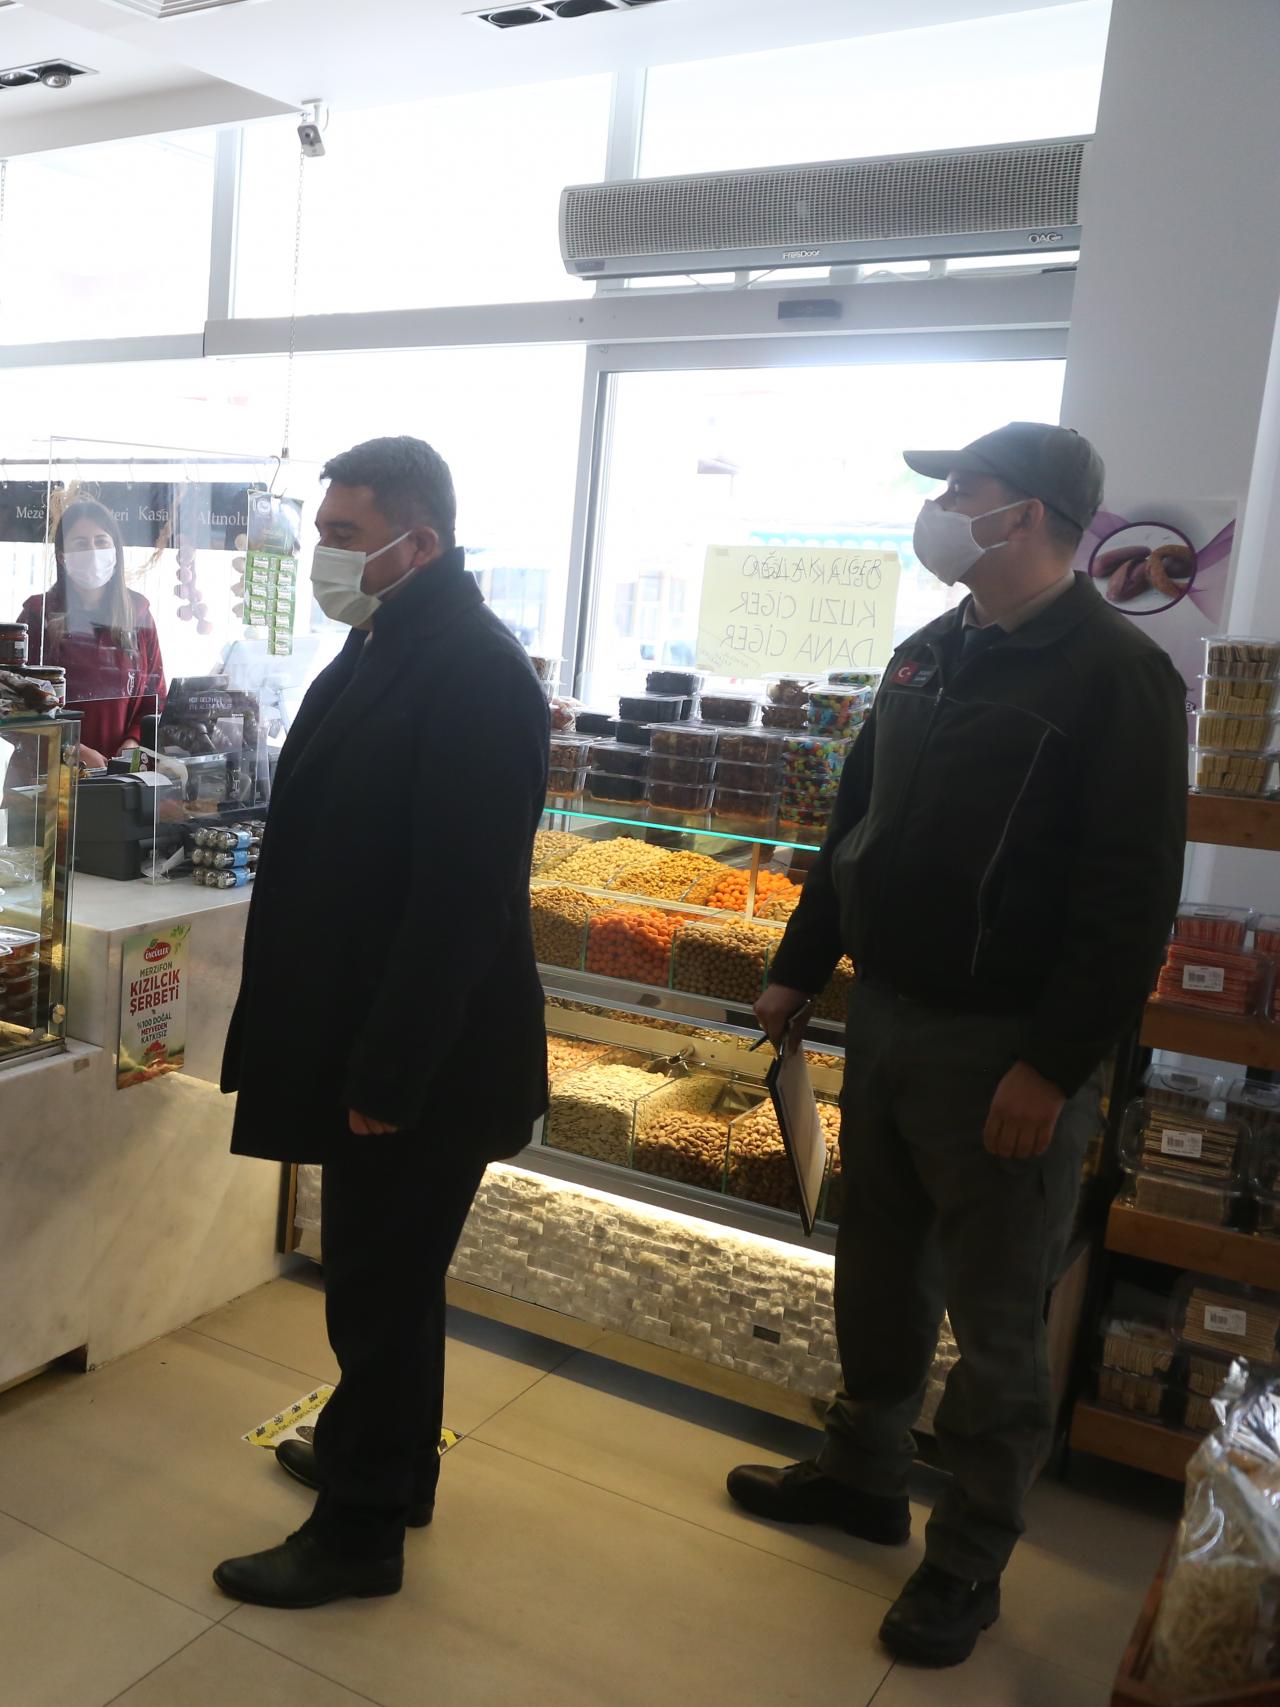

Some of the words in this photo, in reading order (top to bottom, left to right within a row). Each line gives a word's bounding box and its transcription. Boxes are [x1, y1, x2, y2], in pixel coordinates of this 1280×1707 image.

[15, 506, 45, 520] Meze
[137, 506, 170, 521] Kasa
[200, 511, 248, 527] Altınolu
[129, 968, 181, 998] KIZILCIK
[129, 984, 180, 1017] ŞERBETİ
